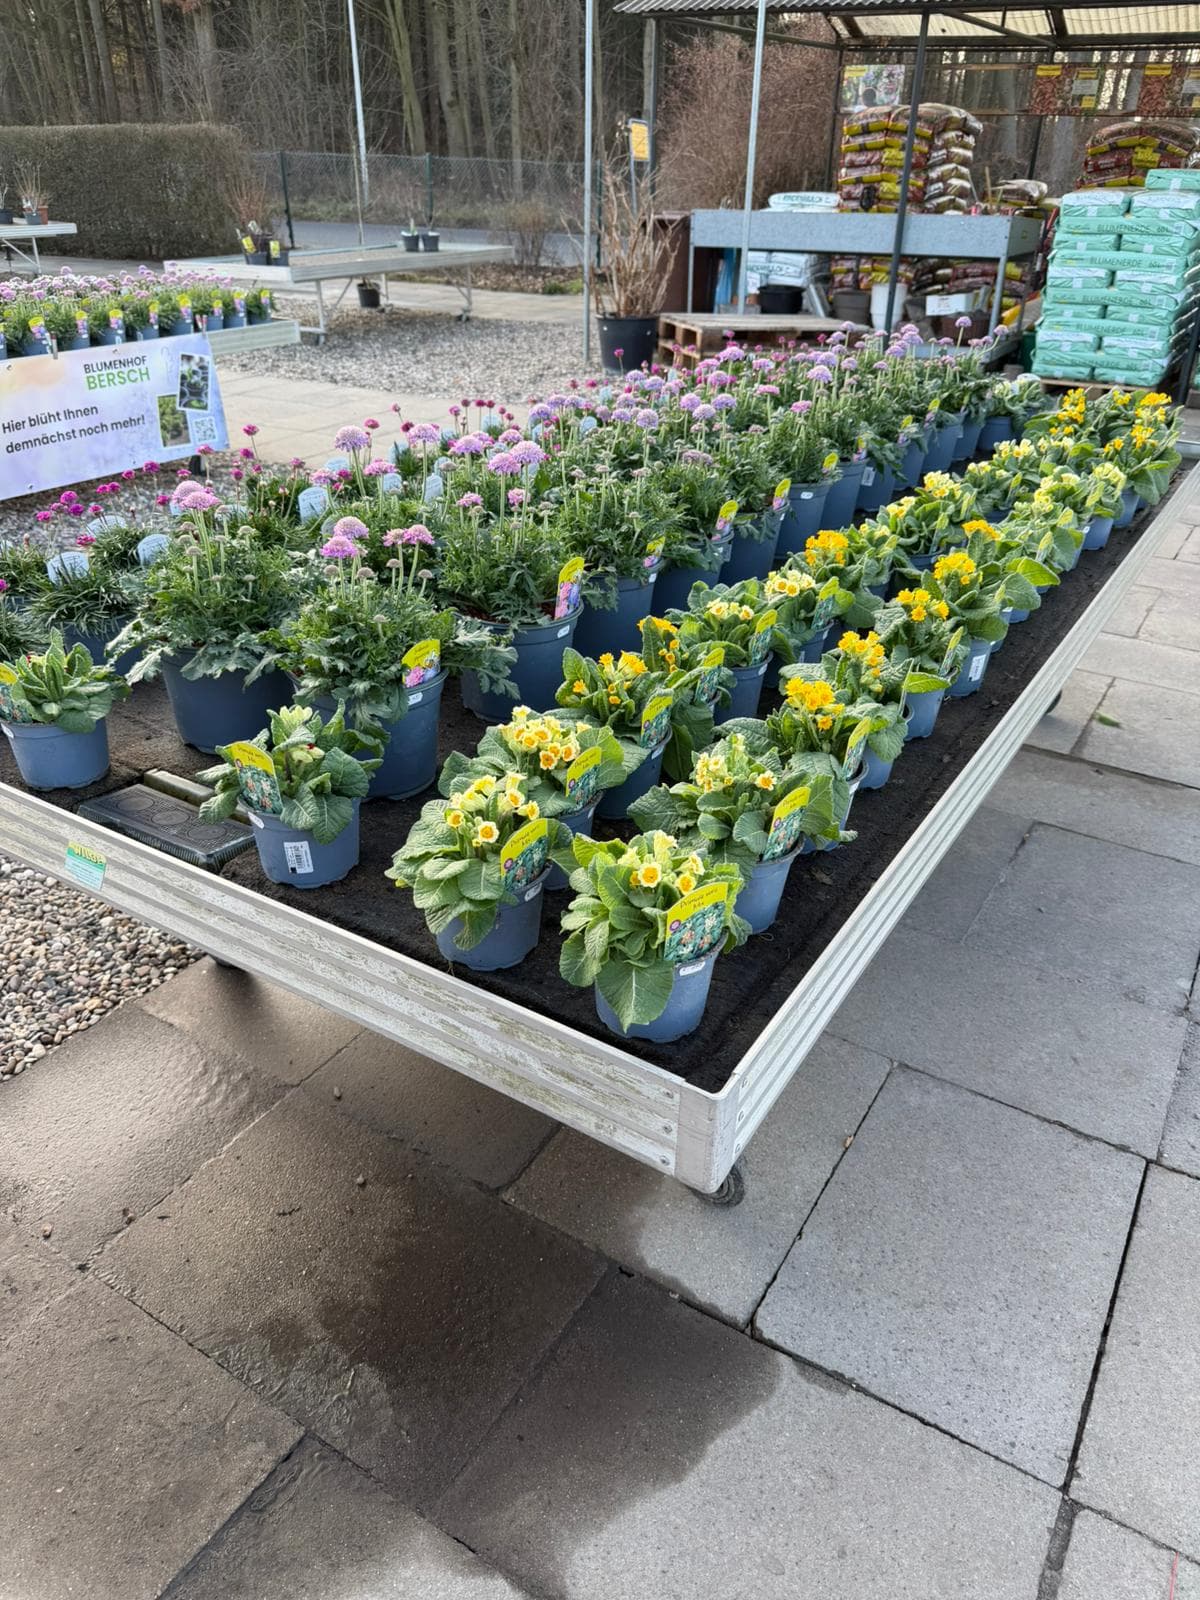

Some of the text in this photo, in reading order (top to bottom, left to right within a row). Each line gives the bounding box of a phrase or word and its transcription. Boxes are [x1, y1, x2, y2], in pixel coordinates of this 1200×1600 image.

[1097, 223, 1150, 234] BLUMENERDE
[1090, 256, 1142, 268] BLUMENERDE
[84, 355, 147, 374] BLUMENHOF
[86, 367, 150, 390] BERSCH
[2, 405, 98, 434] Hier blüht Ihnen
[6, 414, 145, 453] demnächst noch mehr!
